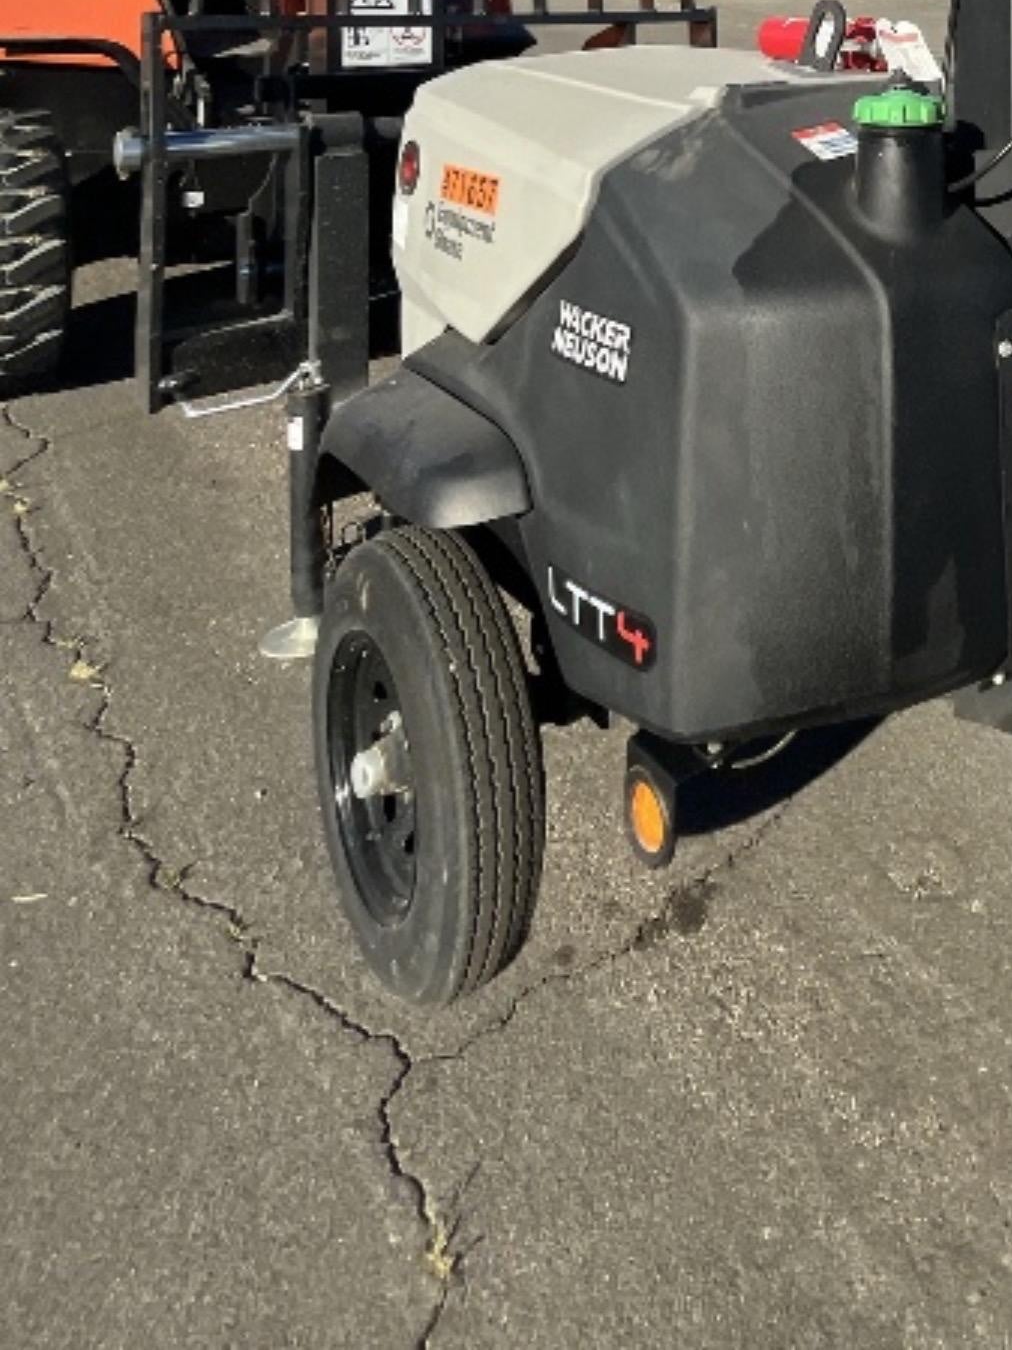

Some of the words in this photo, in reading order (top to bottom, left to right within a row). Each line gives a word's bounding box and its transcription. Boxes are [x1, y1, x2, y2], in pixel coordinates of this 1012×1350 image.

[552, 326, 628, 382] NEUSON
[559, 299, 632, 355] WACKER
[547, 565, 650, 664] LTT4
